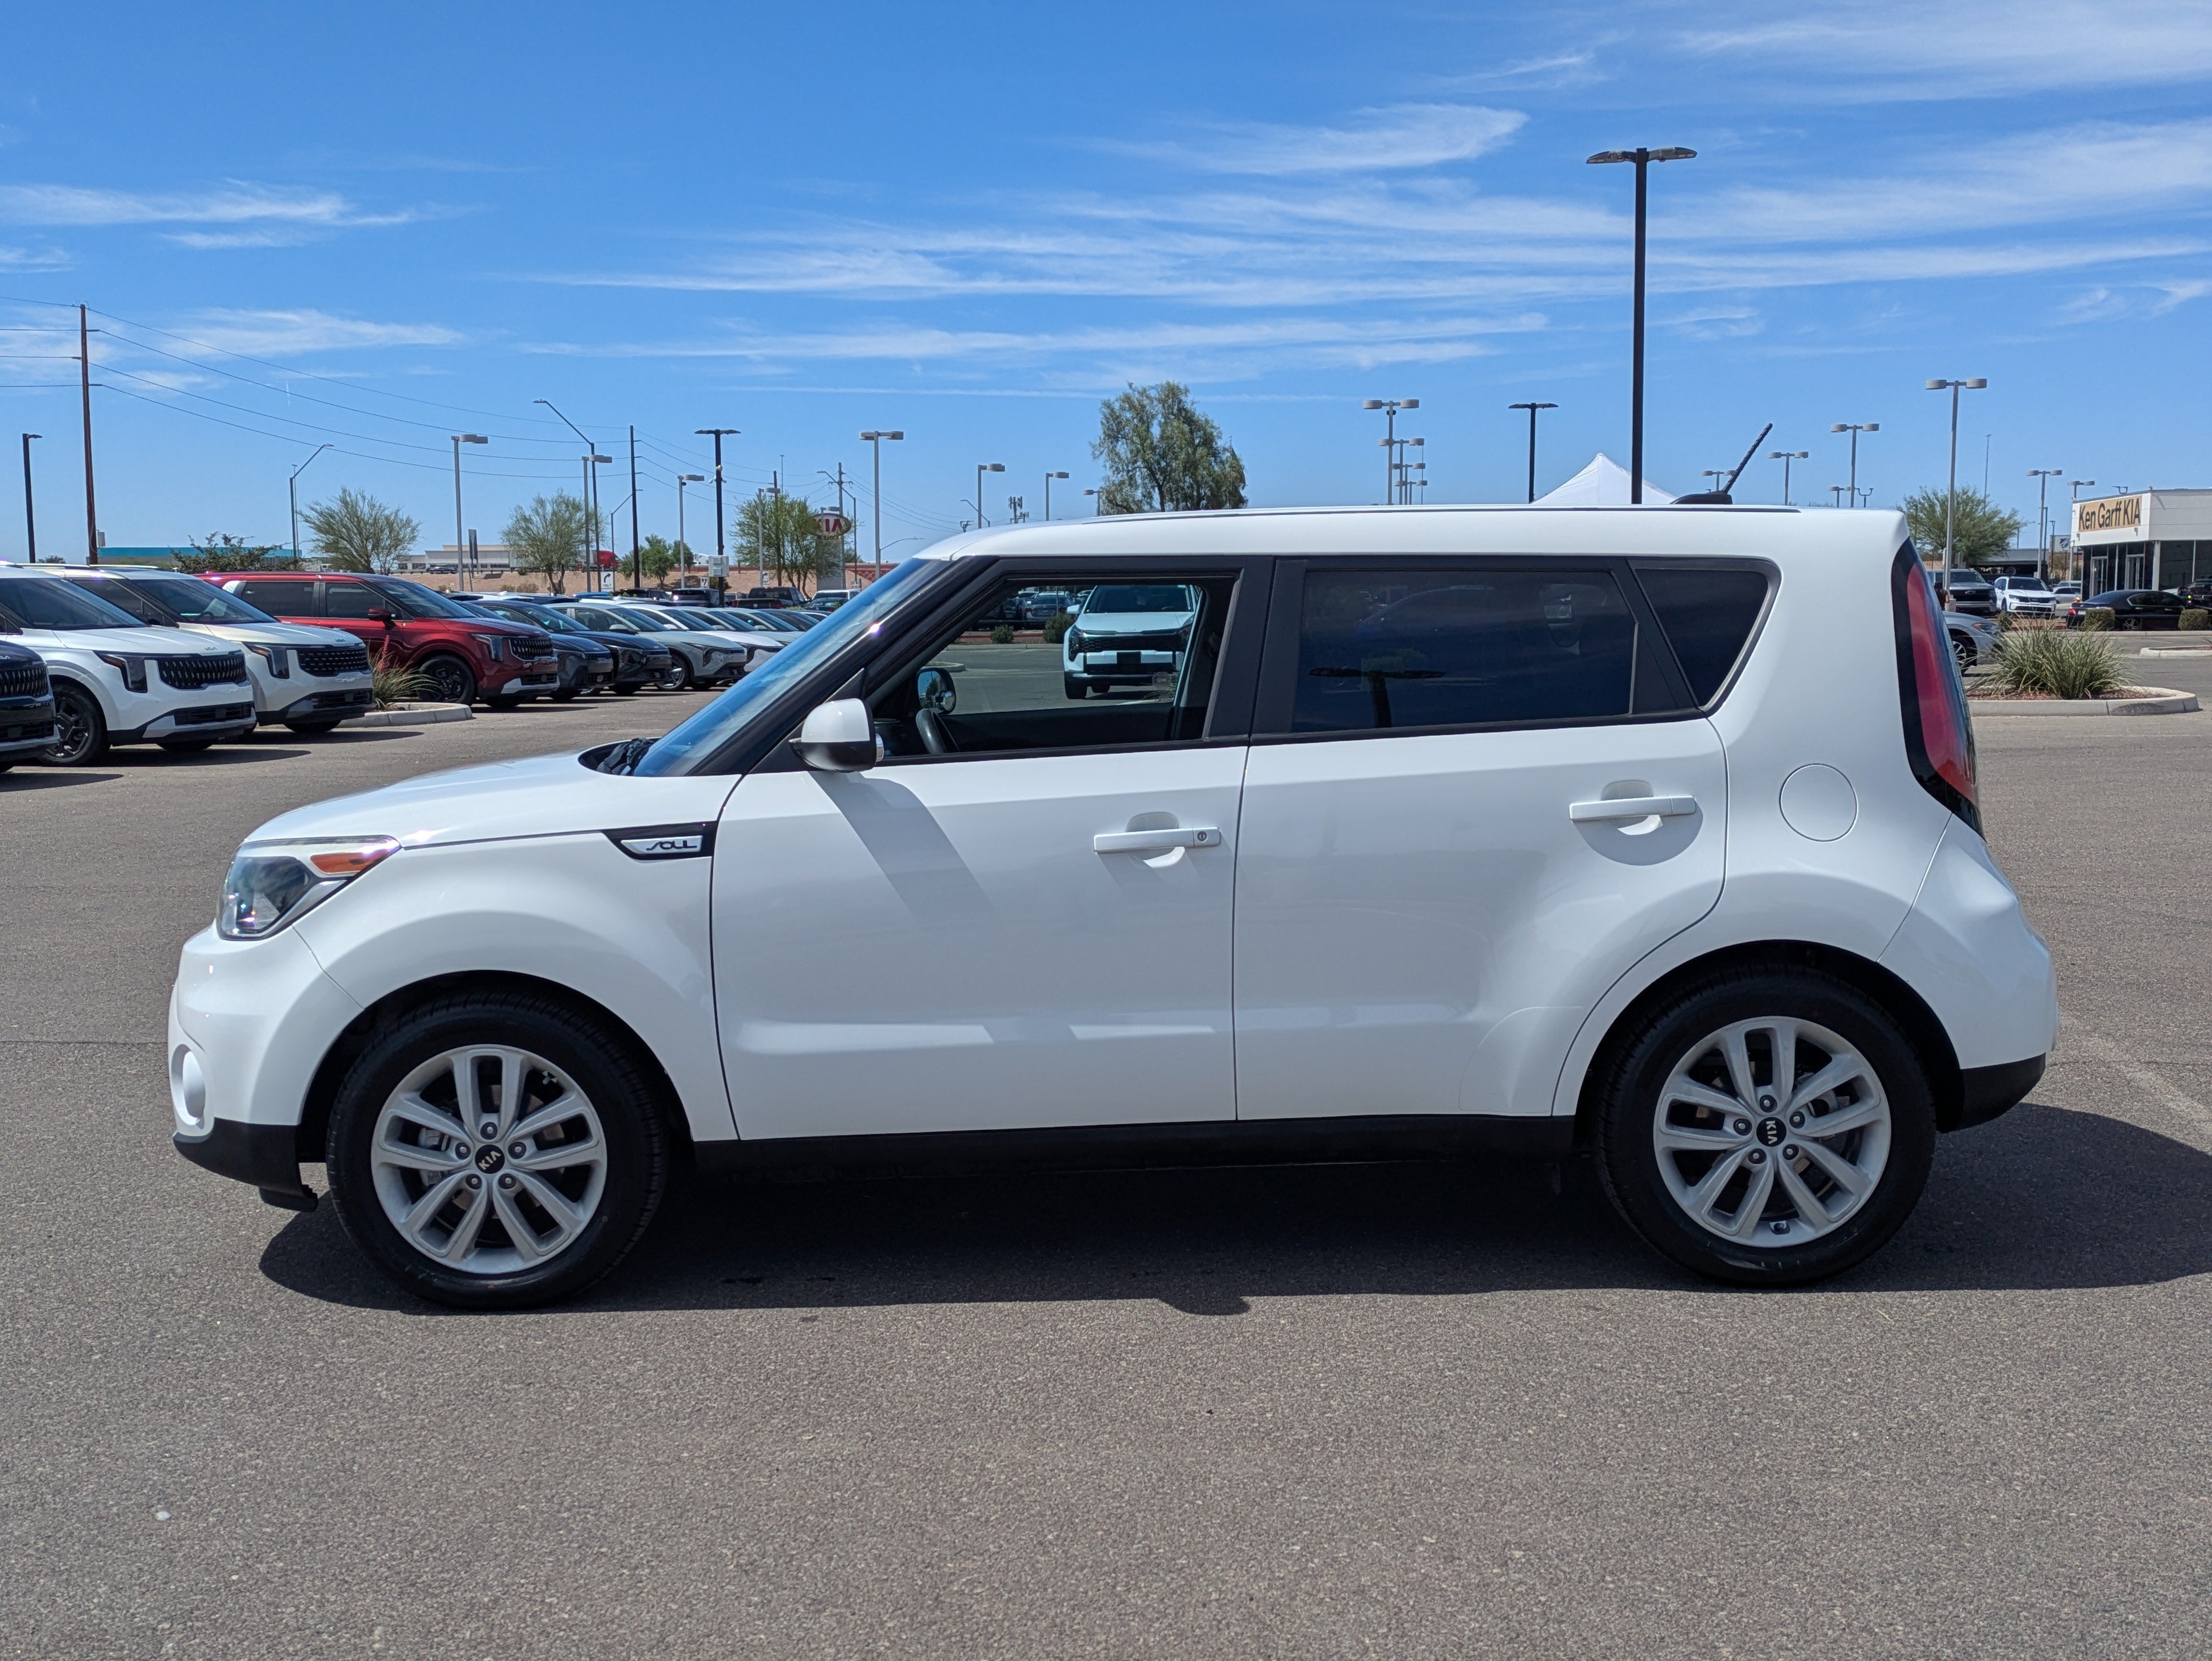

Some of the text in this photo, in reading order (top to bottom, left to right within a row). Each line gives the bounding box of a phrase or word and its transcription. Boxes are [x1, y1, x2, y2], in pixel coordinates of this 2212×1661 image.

[2079, 498, 2141, 530] Ken Garff KIA
[1766, 1120, 1778, 1144] KIA
[478, 1151, 501, 1170] KIA
